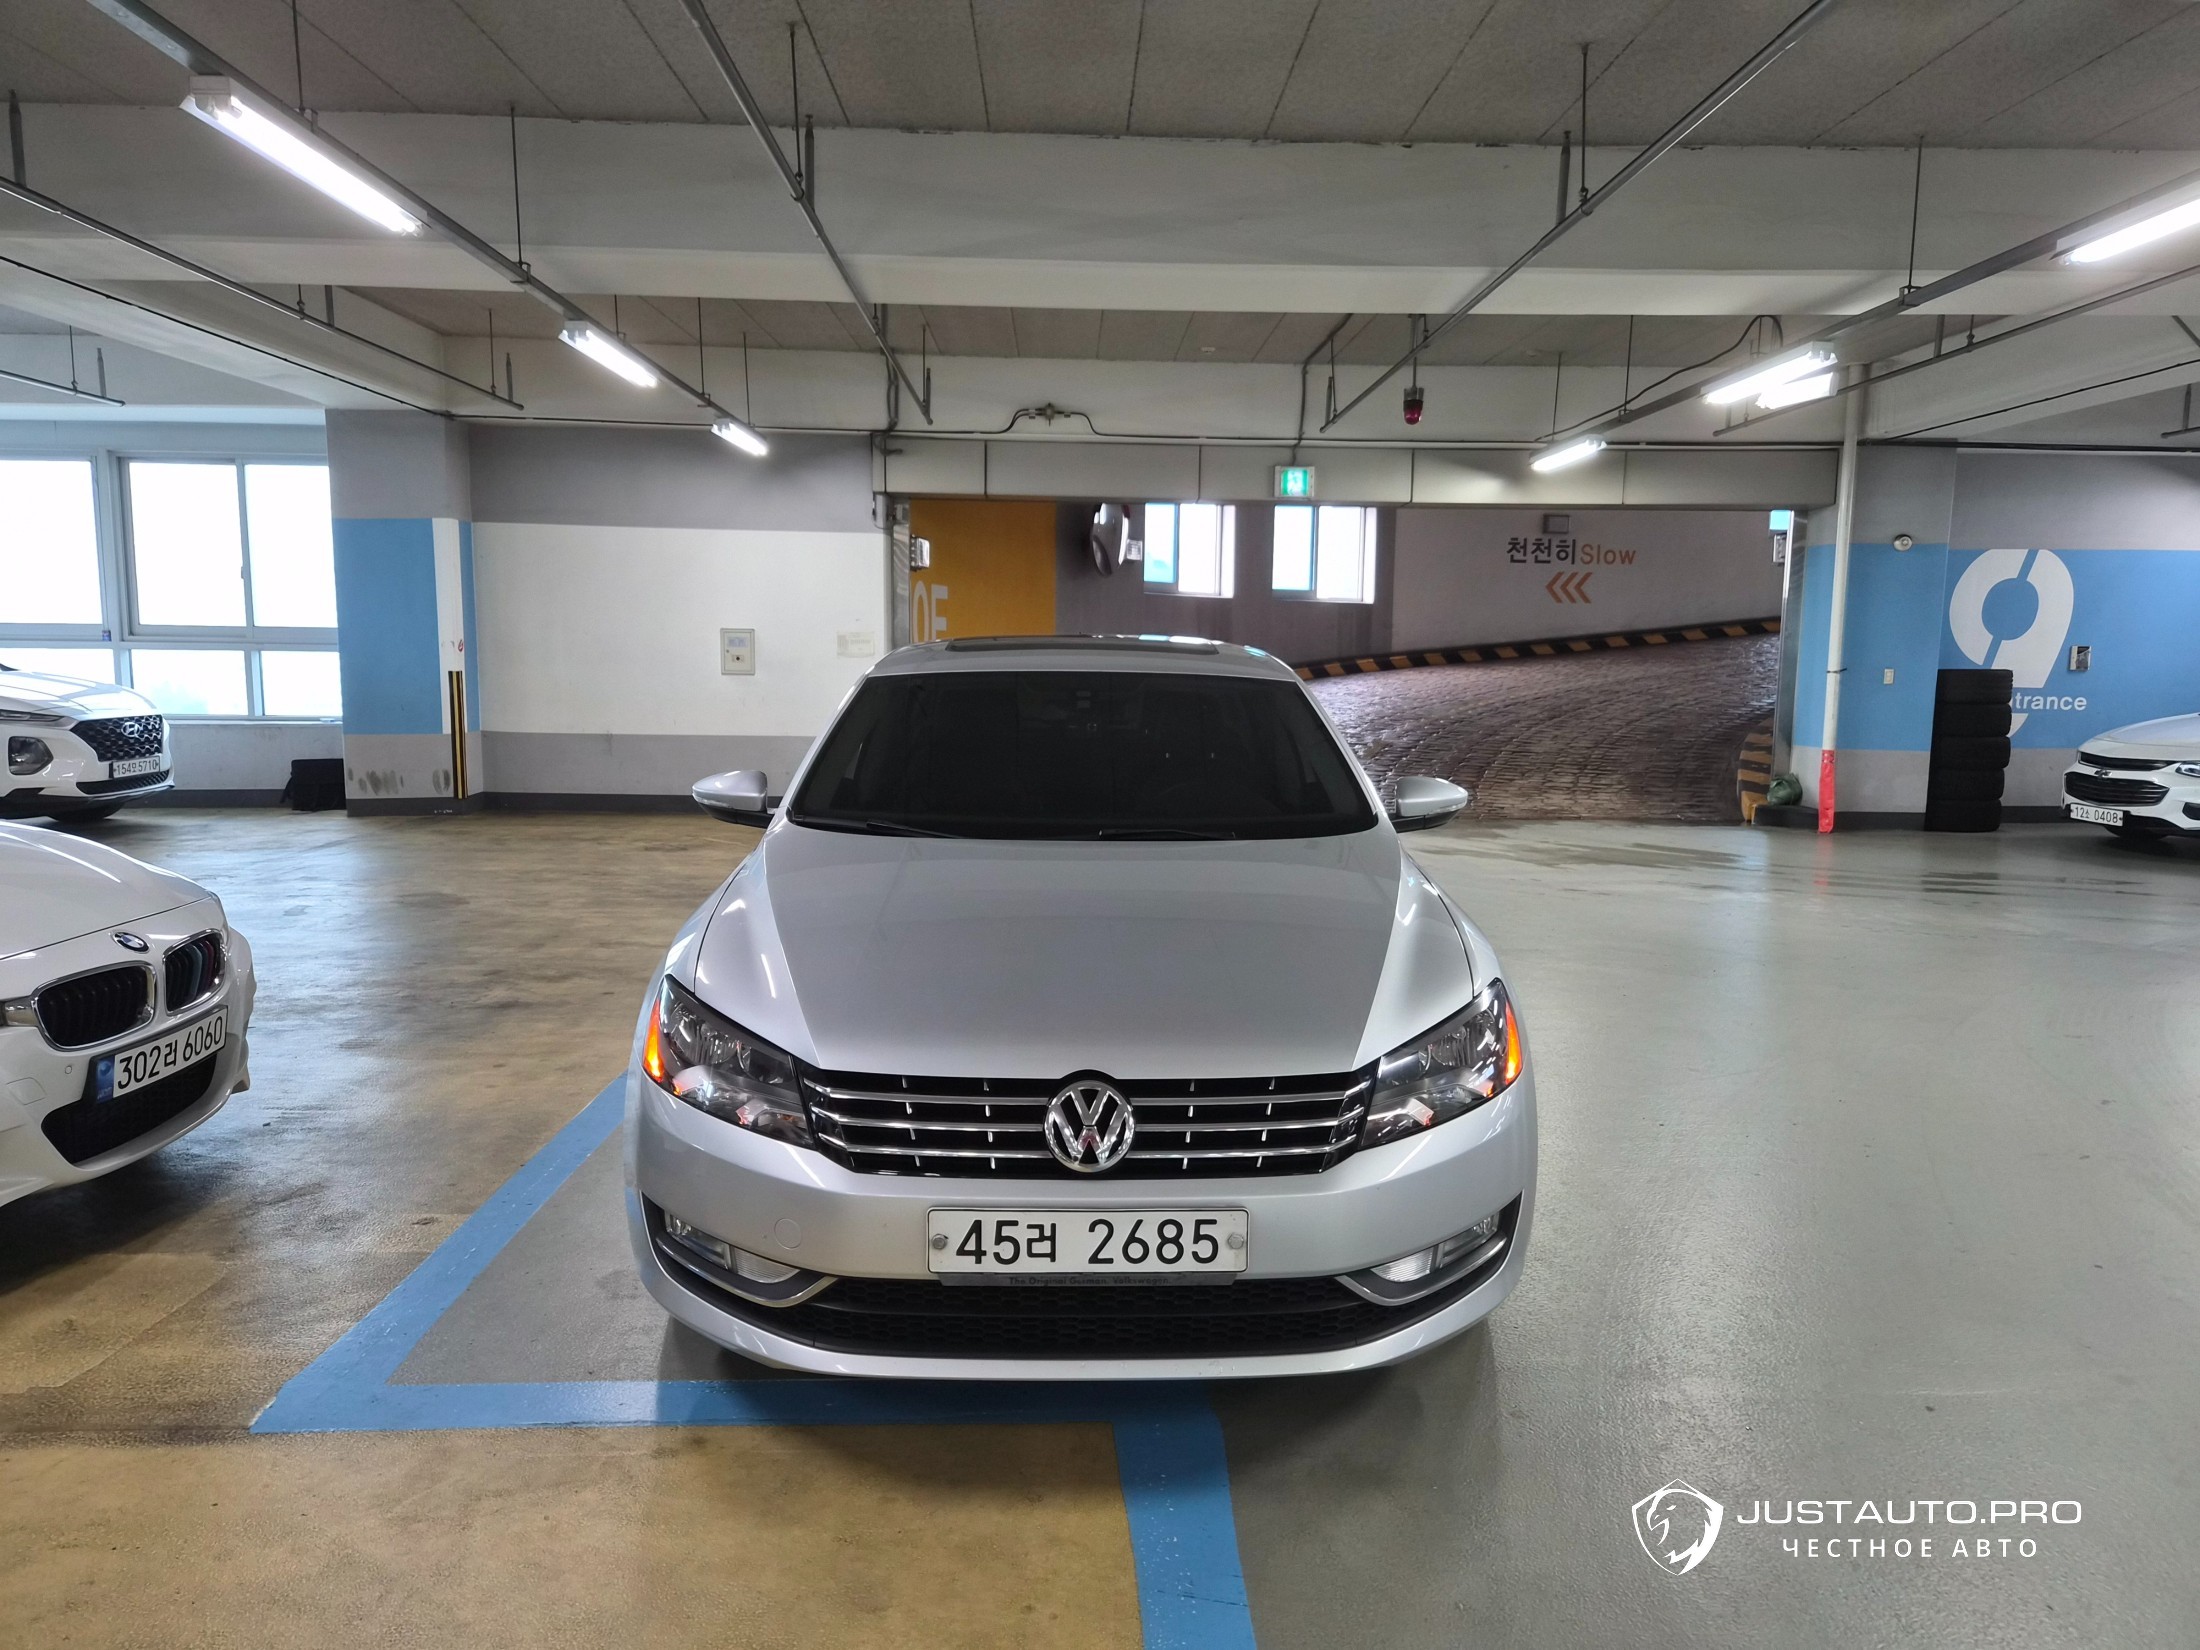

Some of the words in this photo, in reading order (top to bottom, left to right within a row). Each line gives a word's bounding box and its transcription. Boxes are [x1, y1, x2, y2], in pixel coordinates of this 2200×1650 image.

[1506, 537, 1576, 565] 천천히
[1580, 543, 1637, 565] Slow
[2011, 691, 2088, 711] trance
[2093, 809, 2118, 823] 0408
[117, 1039, 178, 1090] 302러
[182, 1015, 223, 1062] 6060
[955, 1219, 1057, 1265] 45러
[1087, 1218, 1219, 1265] 2685
